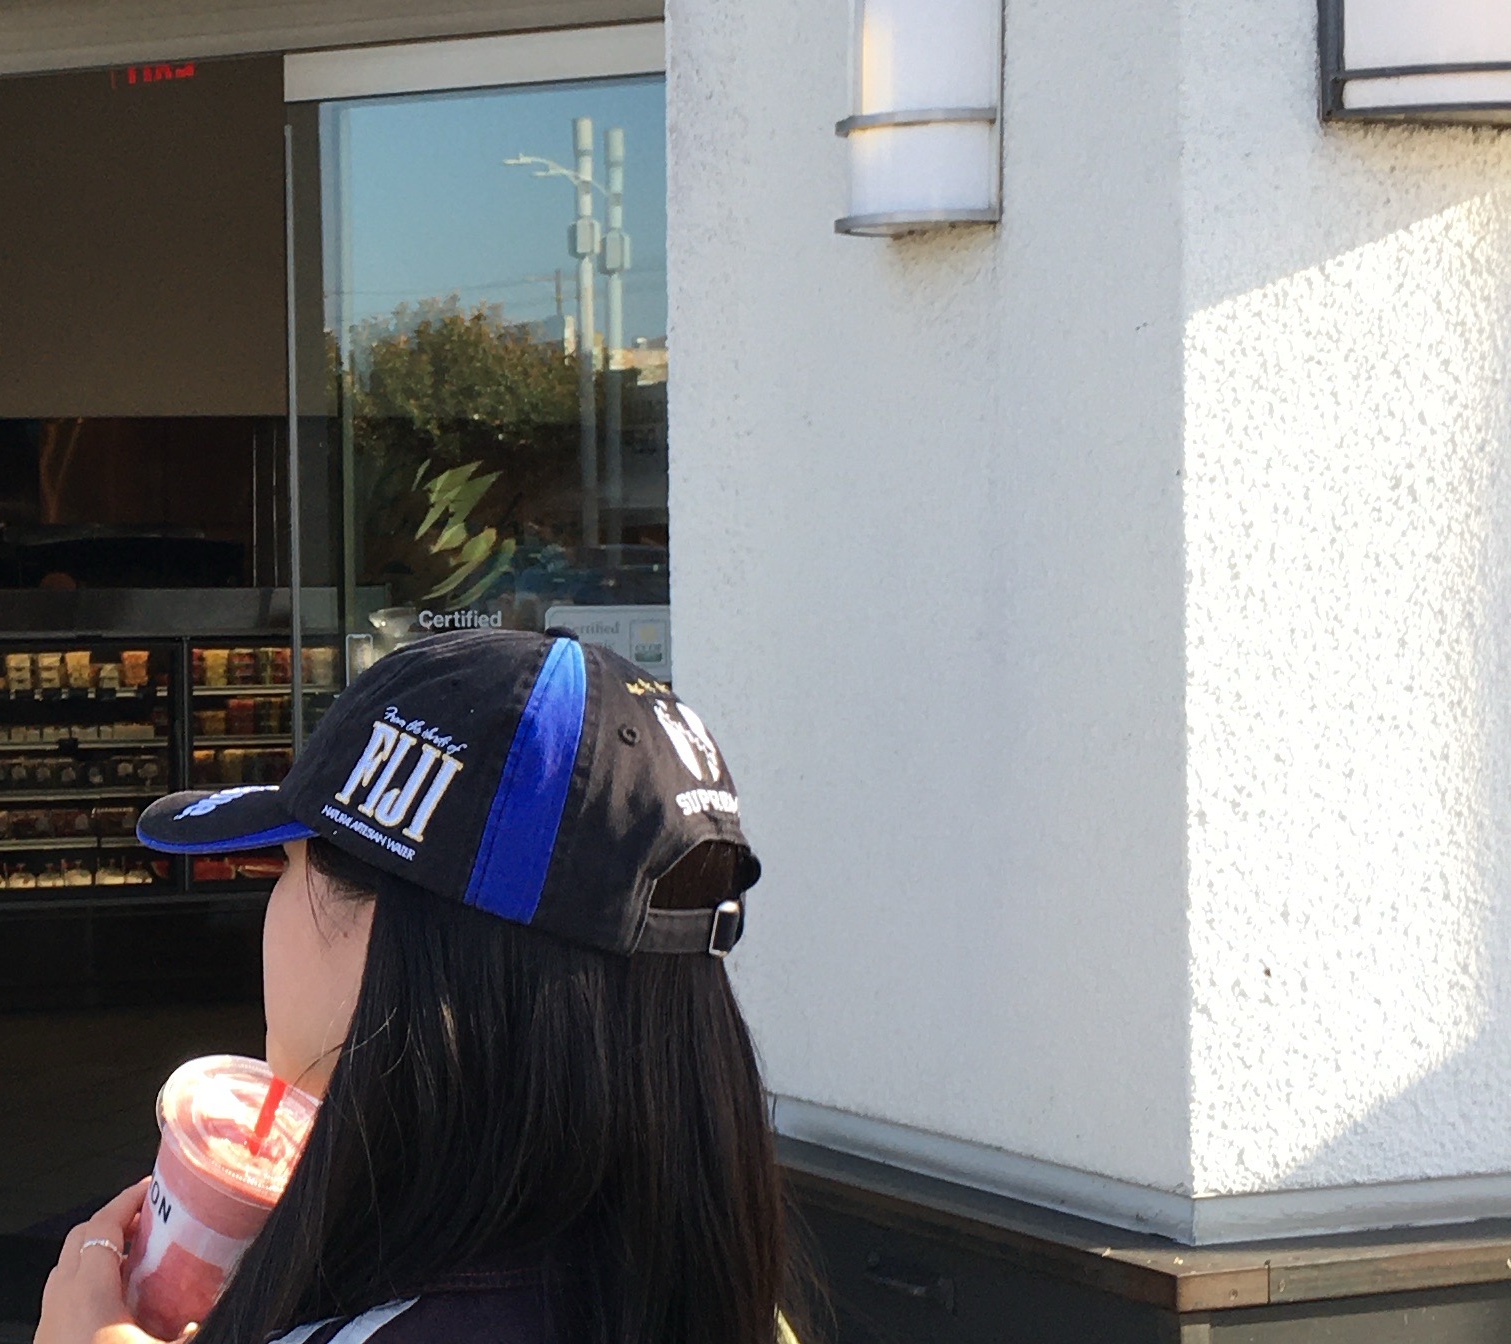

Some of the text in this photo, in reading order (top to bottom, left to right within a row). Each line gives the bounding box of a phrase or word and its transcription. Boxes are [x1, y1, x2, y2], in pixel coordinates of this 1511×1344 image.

[418, 610, 502, 629] Certified
[562, 620, 620, 635] ertified
[335, 720, 464, 843] FIJI
[320, 804, 353, 827] NATURAL
[386, 837, 416, 861] WATER
